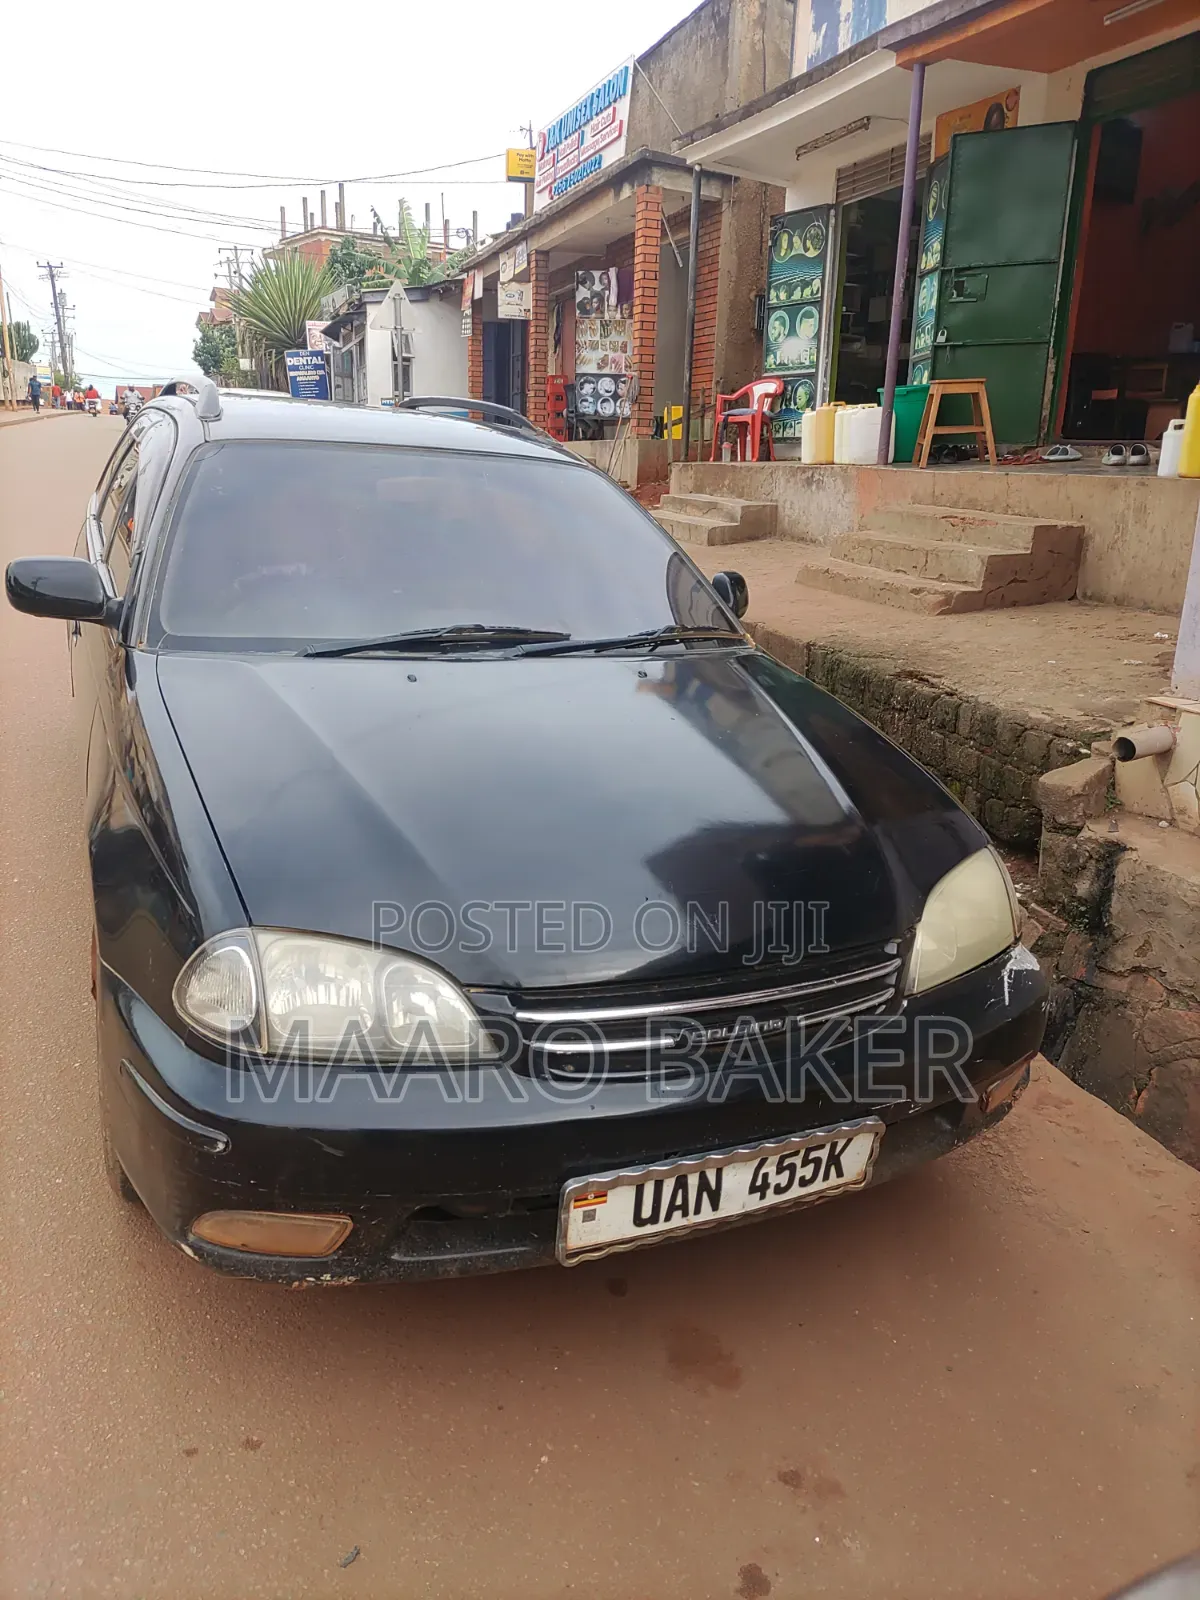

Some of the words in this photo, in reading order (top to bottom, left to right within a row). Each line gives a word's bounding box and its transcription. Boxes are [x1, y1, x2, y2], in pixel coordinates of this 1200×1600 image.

[561, 93, 595, 140] UNISEX
[592, 66, 629, 116] SALON
[287, 356, 325, 366] DENTAL
[633, 1168, 723, 1228] UAN
[748, 1138, 854, 1201] 455K
